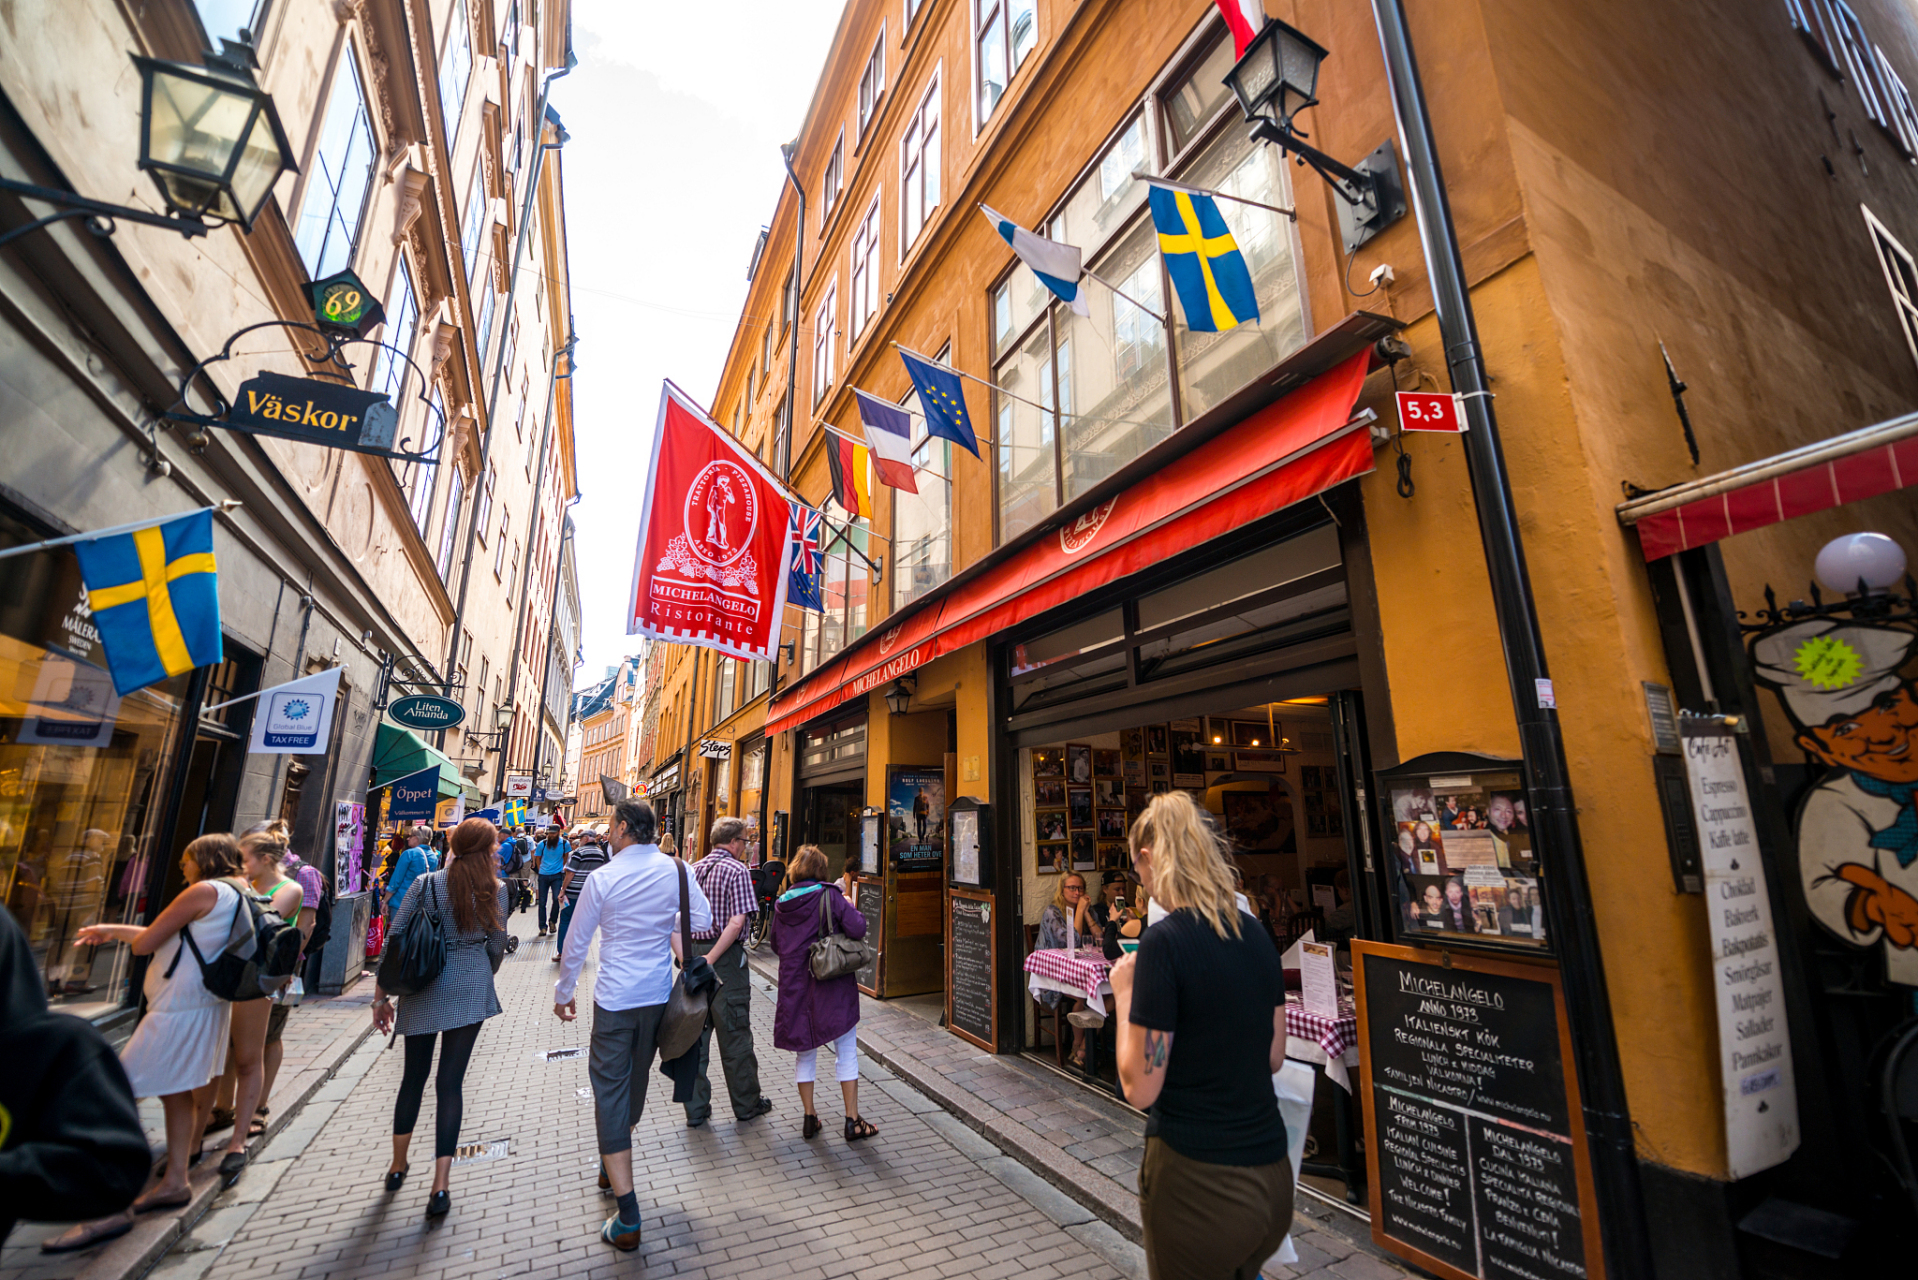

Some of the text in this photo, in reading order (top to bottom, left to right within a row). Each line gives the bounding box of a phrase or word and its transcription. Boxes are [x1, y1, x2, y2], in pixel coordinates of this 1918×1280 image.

[325, 290, 361, 316] 69
[247, 390, 358, 432] Väskor
[1407, 401, 1444, 422] 5,3
[692, 466, 752, 522] TRATTORIA PIZZAHOUSE
[717, 547, 738, 562] 1973
[652, 583, 756, 616] MICHELANGELO
[650, 601, 754, 635] Ristorante
[68, 635, 92, 651] SWEDEN
[852, 649, 920, 697] MICHELANGELO
[404, 707, 449, 720] Amanda
[415, 701, 441, 712] Liten
[288, 736, 310, 744] FREE
[700, 740, 731, 759] Steps
[396, 786, 432, 802] Öppet
[1701, 777, 1738, 798] Espresso
[1701, 802, 1748, 825] Cappuccino
[919, 844, 932, 852] MAN
[1708, 828, 1750, 849] Kaffe latte
[913, 851, 931, 859] HETER
[932, 850, 942, 858] OVE
[1720, 877, 1756, 900] Choklad
[1724, 904, 1760, 928] Bakverk
[1722, 932, 1769, 958] Bakpotatis
[1724, 959, 1772, 985] Smörgåsar
[1399, 971, 1505, 1009] MICHELANGELO
[1732, 988, 1772, 1014] Matpajer
[1419, 1000, 1479, 1022] ANNO 1973
[1404, 1014, 1500, 1049] ITALIENSKT KÖK
[1736, 1016, 1774, 1041] Sallader
[1394, 1028, 1536, 1074] REGIONALA SPECIALITETER
[1732, 1043, 1783, 1071] Pannkakor
[1384, 1066, 1423, 1087] FAMILJEN
[1421, 1051, 1449, 1067] LUNCH
[1461, 1061, 1497, 1079] MIDDAG
[1389, 1096, 1456, 1129] MICHELANGELO
[1394, 1114, 1440, 1137] FROM 1973
[1384, 1139, 1420, 1162] REGIONAL
[1387, 1126, 1458, 1160] ITALIAN CUISINE
[1483, 1127, 1562, 1163] MICHELANGELO
[1491, 1145, 1545, 1172] DAL 1973
[1394, 1156, 1421, 1175] LUNCH
[1430, 1170, 1462, 1191] DINNER
[1479, 1157, 1562, 1195] CUCINA ITALIANA
[1399, 1174, 1451, 1206] WELCOME!
[1388, 1188, 1404, 1204] THE
[1439, 1208, 1467, 1233] FAMILY
[1484, 1187, 1522, 1214] PRANZO
[1532, 1207, 1562, 1229] CENA
[1483, 1226, 1498, 1242] LA
[1498, 1233, 1540, 1260] FAMIGLIA
